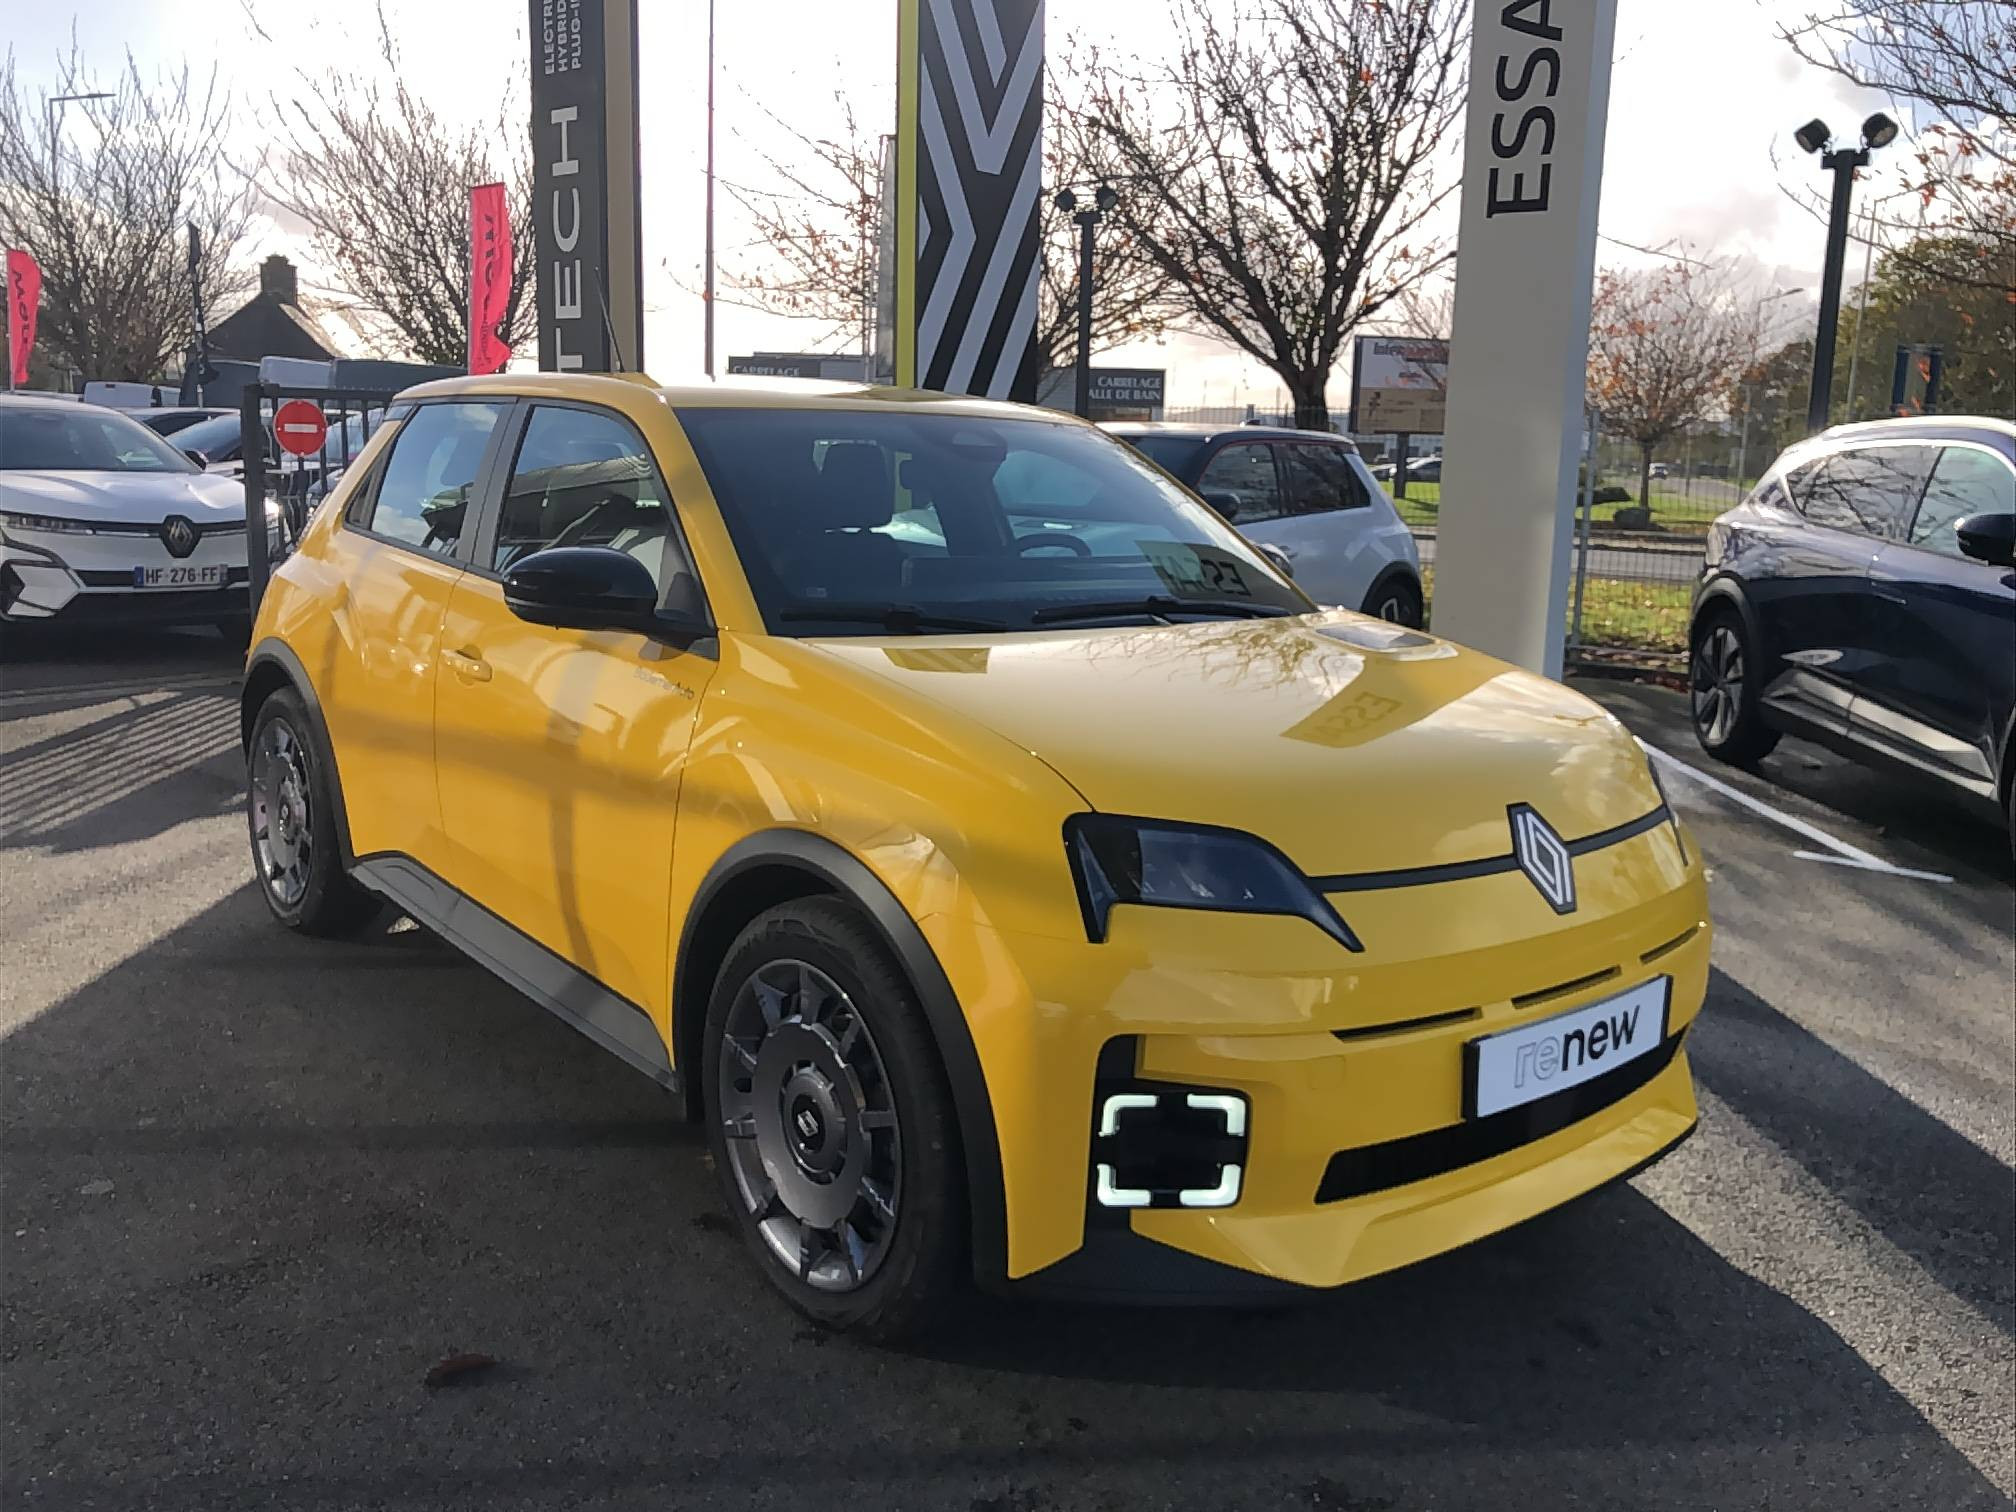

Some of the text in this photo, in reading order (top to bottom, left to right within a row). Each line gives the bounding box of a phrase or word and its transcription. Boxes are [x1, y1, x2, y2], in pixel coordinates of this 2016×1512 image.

[1486, 0, 1563, 219] ESSA
[551, 105, 583, 373] TECH
[1088, 389, 1160, 400] ALLE DE BAIN
[1097, 376, 1161, 388] CARRELAGE
[1513, 1004, 1641, 1089] renew
